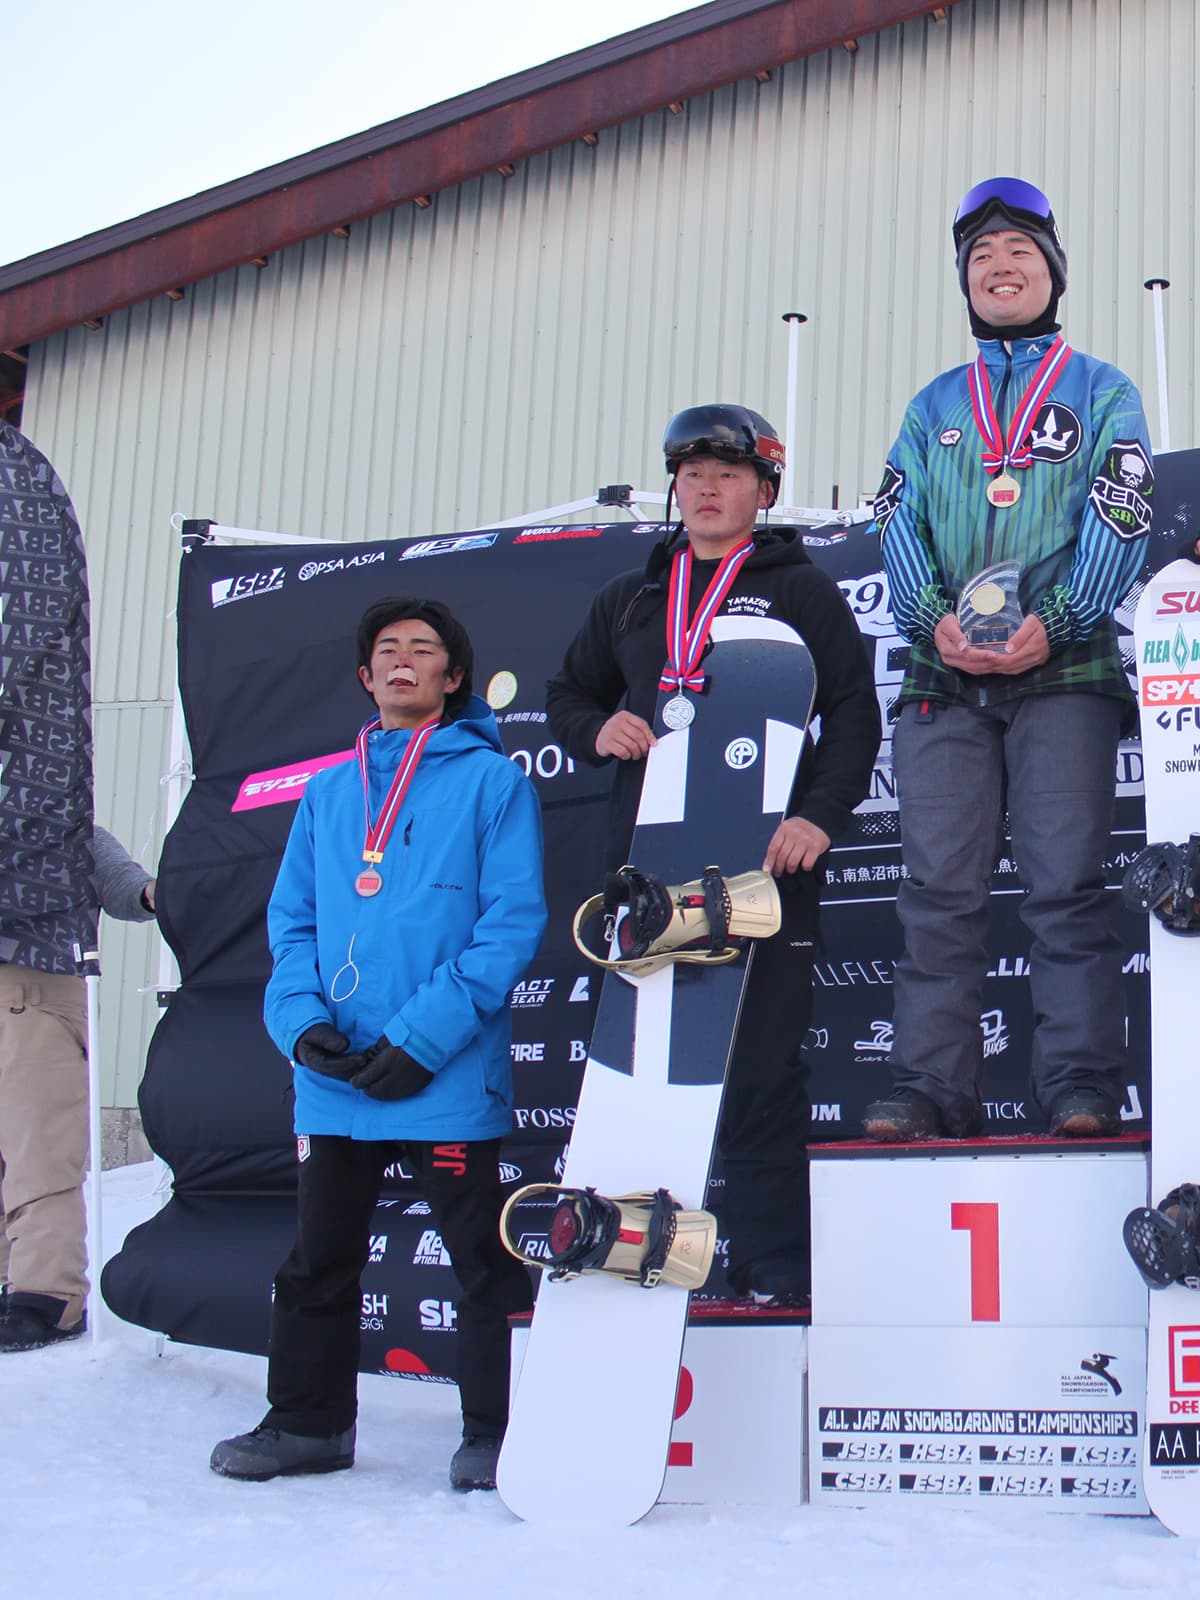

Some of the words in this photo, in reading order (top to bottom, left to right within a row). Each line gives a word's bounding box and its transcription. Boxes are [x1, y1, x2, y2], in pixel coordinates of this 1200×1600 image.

[316, 560, 344, 576] PSA
[346, 551, 386, 569] ASIA
[727, 596, 771, 610] YAMAZEN
[1143, 639, 1170, 665] FLEA
[512, 979, 555, 993] ACT
[950, 1202, 1001, 1322] 1
[823, 1409, 849, 1431] ALL
[852, 1410, 900, 1432] JAPAN
[903, 1410, 1015, 1434] SNOWBOARDING
[1018, 1411, 1134, 1436] CHAMPIONSHIPS
[836, 1442, 894, 1460] JSBA
[911, 1444, 973, 1462] HSBA
[994, 1446, 1054, 1463] TSBA
[1072, 1446, 1137, 1465] KSBA
[1155, 1429, 1187, 1460] AA
[835, 1471, 893, 1490] CSBA
[911, 1474, 973, 1492] ESBA
[990, 1475, 1054, 1494] NSBA
[1072, 1477, 1137, 1496] SSBA
